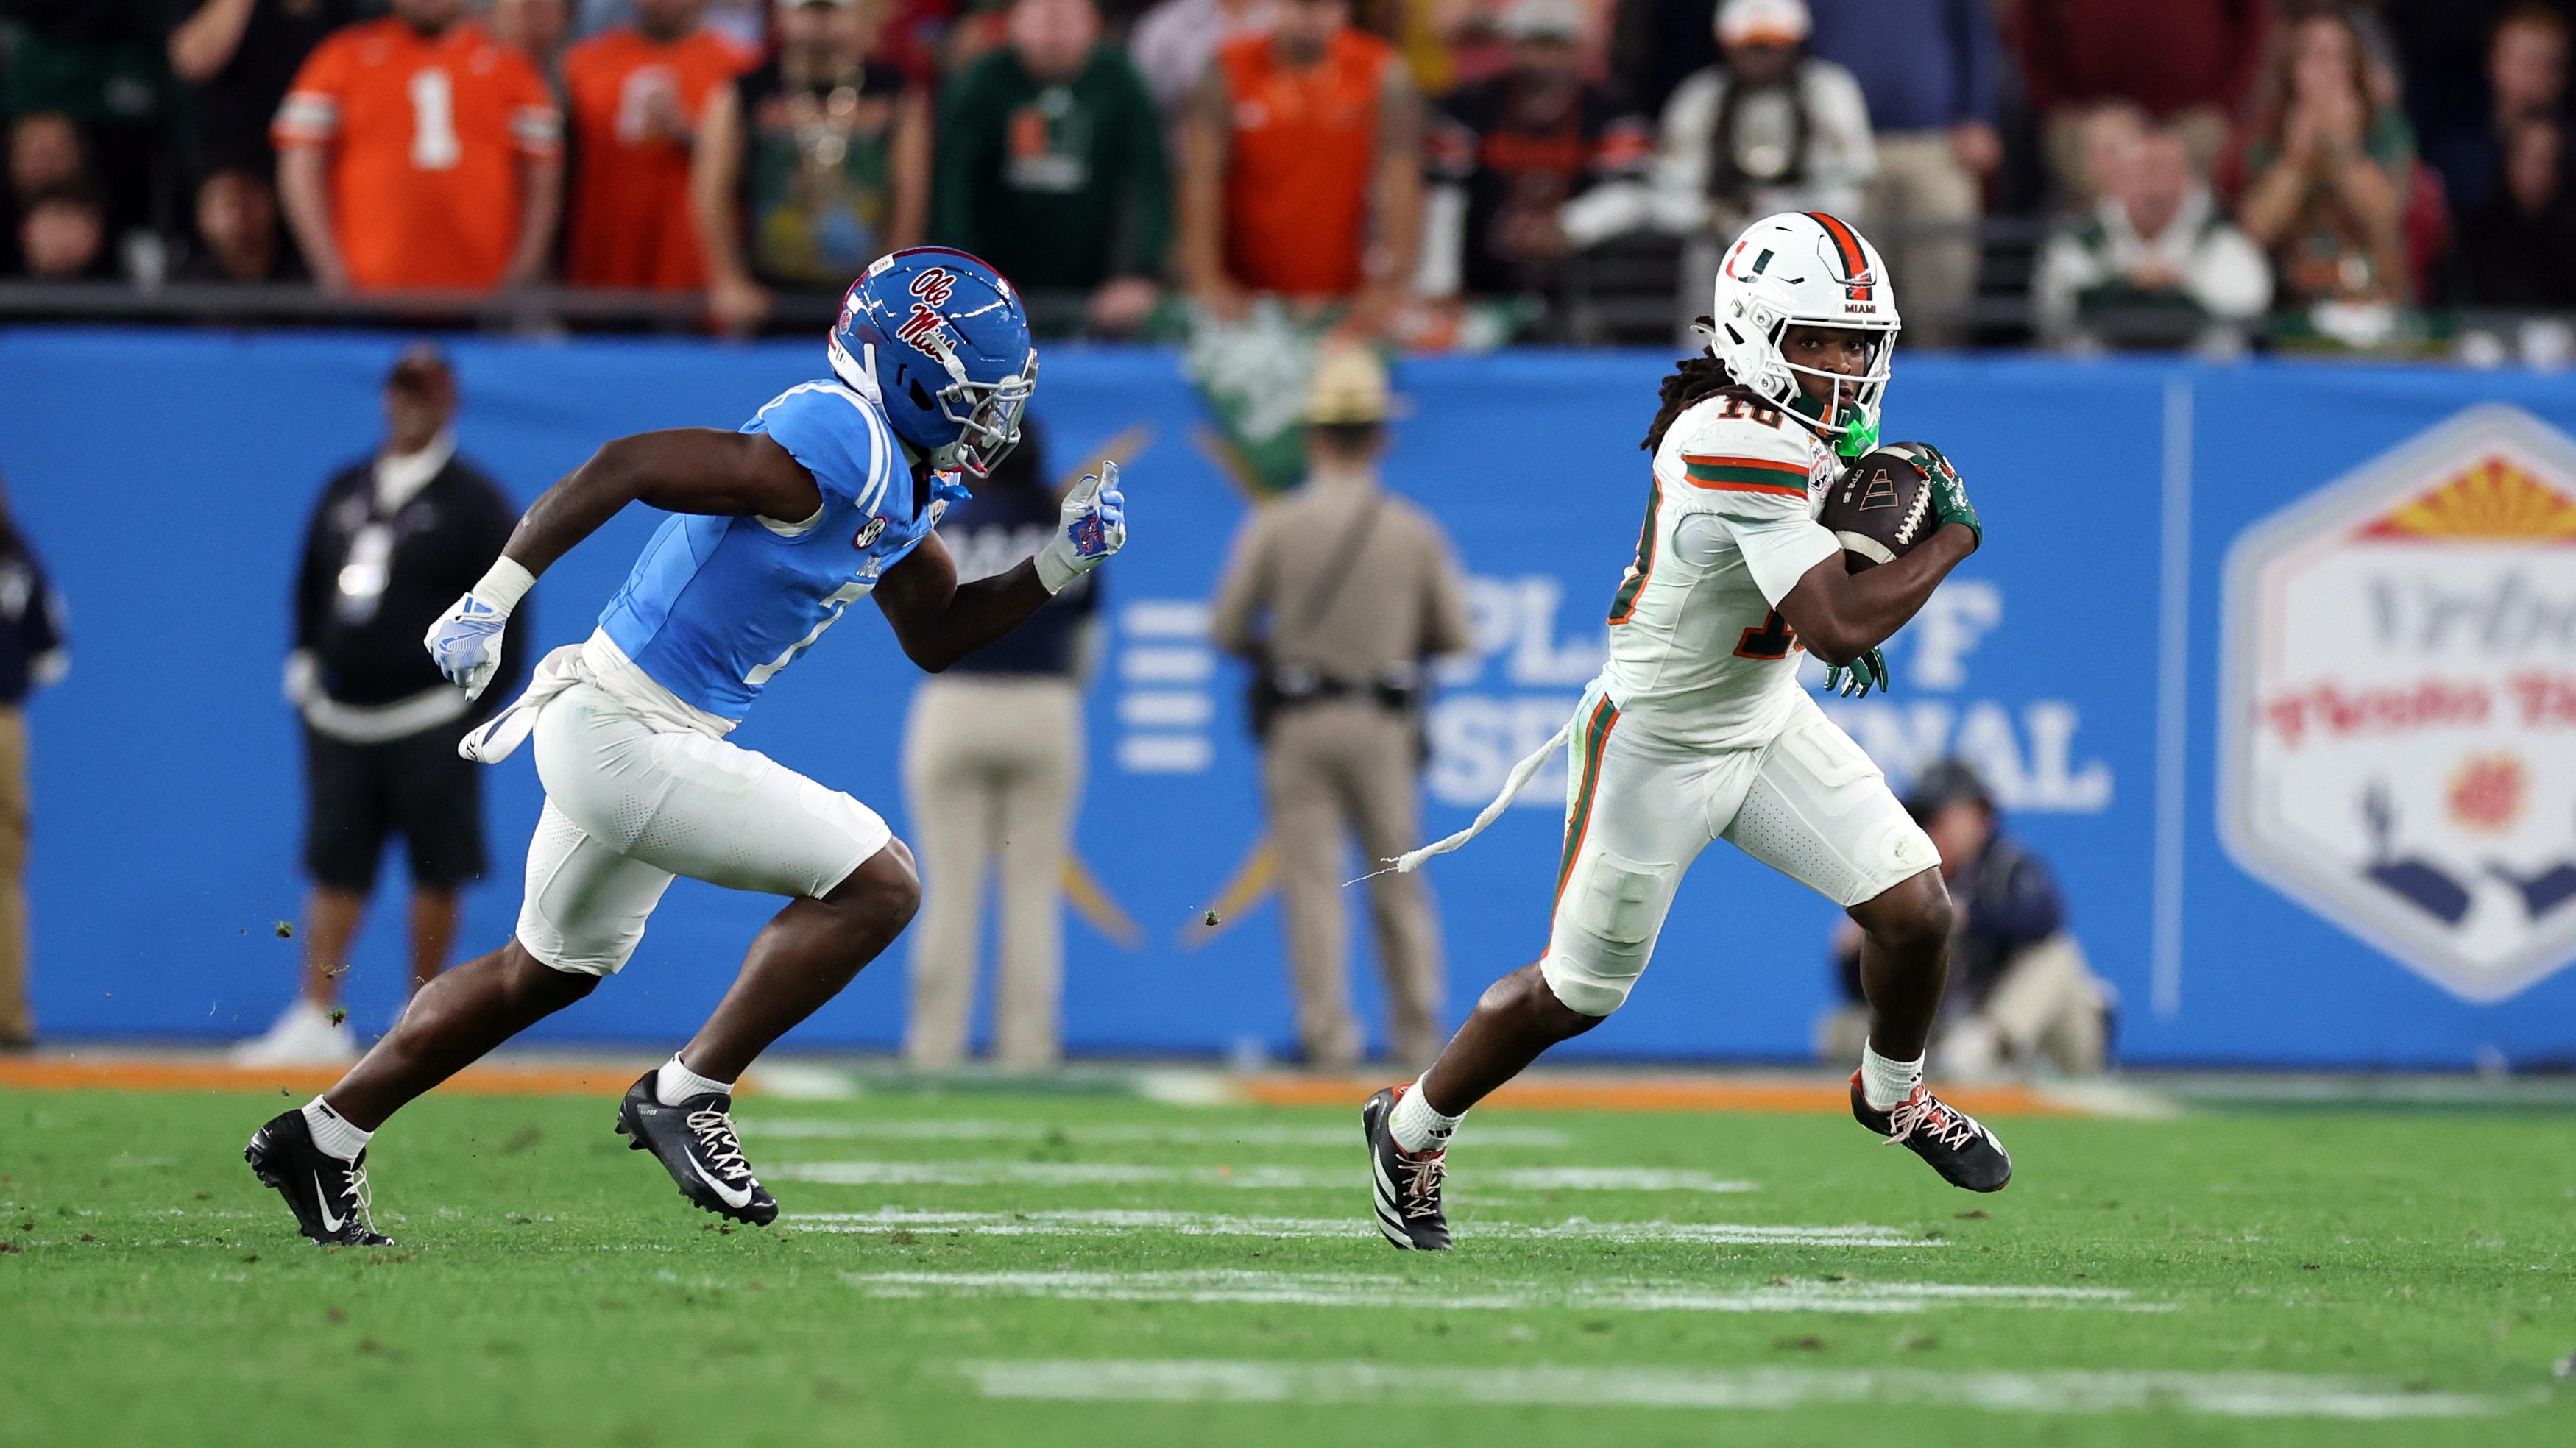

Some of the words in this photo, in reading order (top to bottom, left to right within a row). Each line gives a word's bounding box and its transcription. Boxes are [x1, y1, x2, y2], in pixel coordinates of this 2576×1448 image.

[408, 68, 462, 171] 1
[910, 267, 957, 307] Ole
[1844, 304, 1877, 314] MIAMI
[896, 303, 958, 363] Miss
